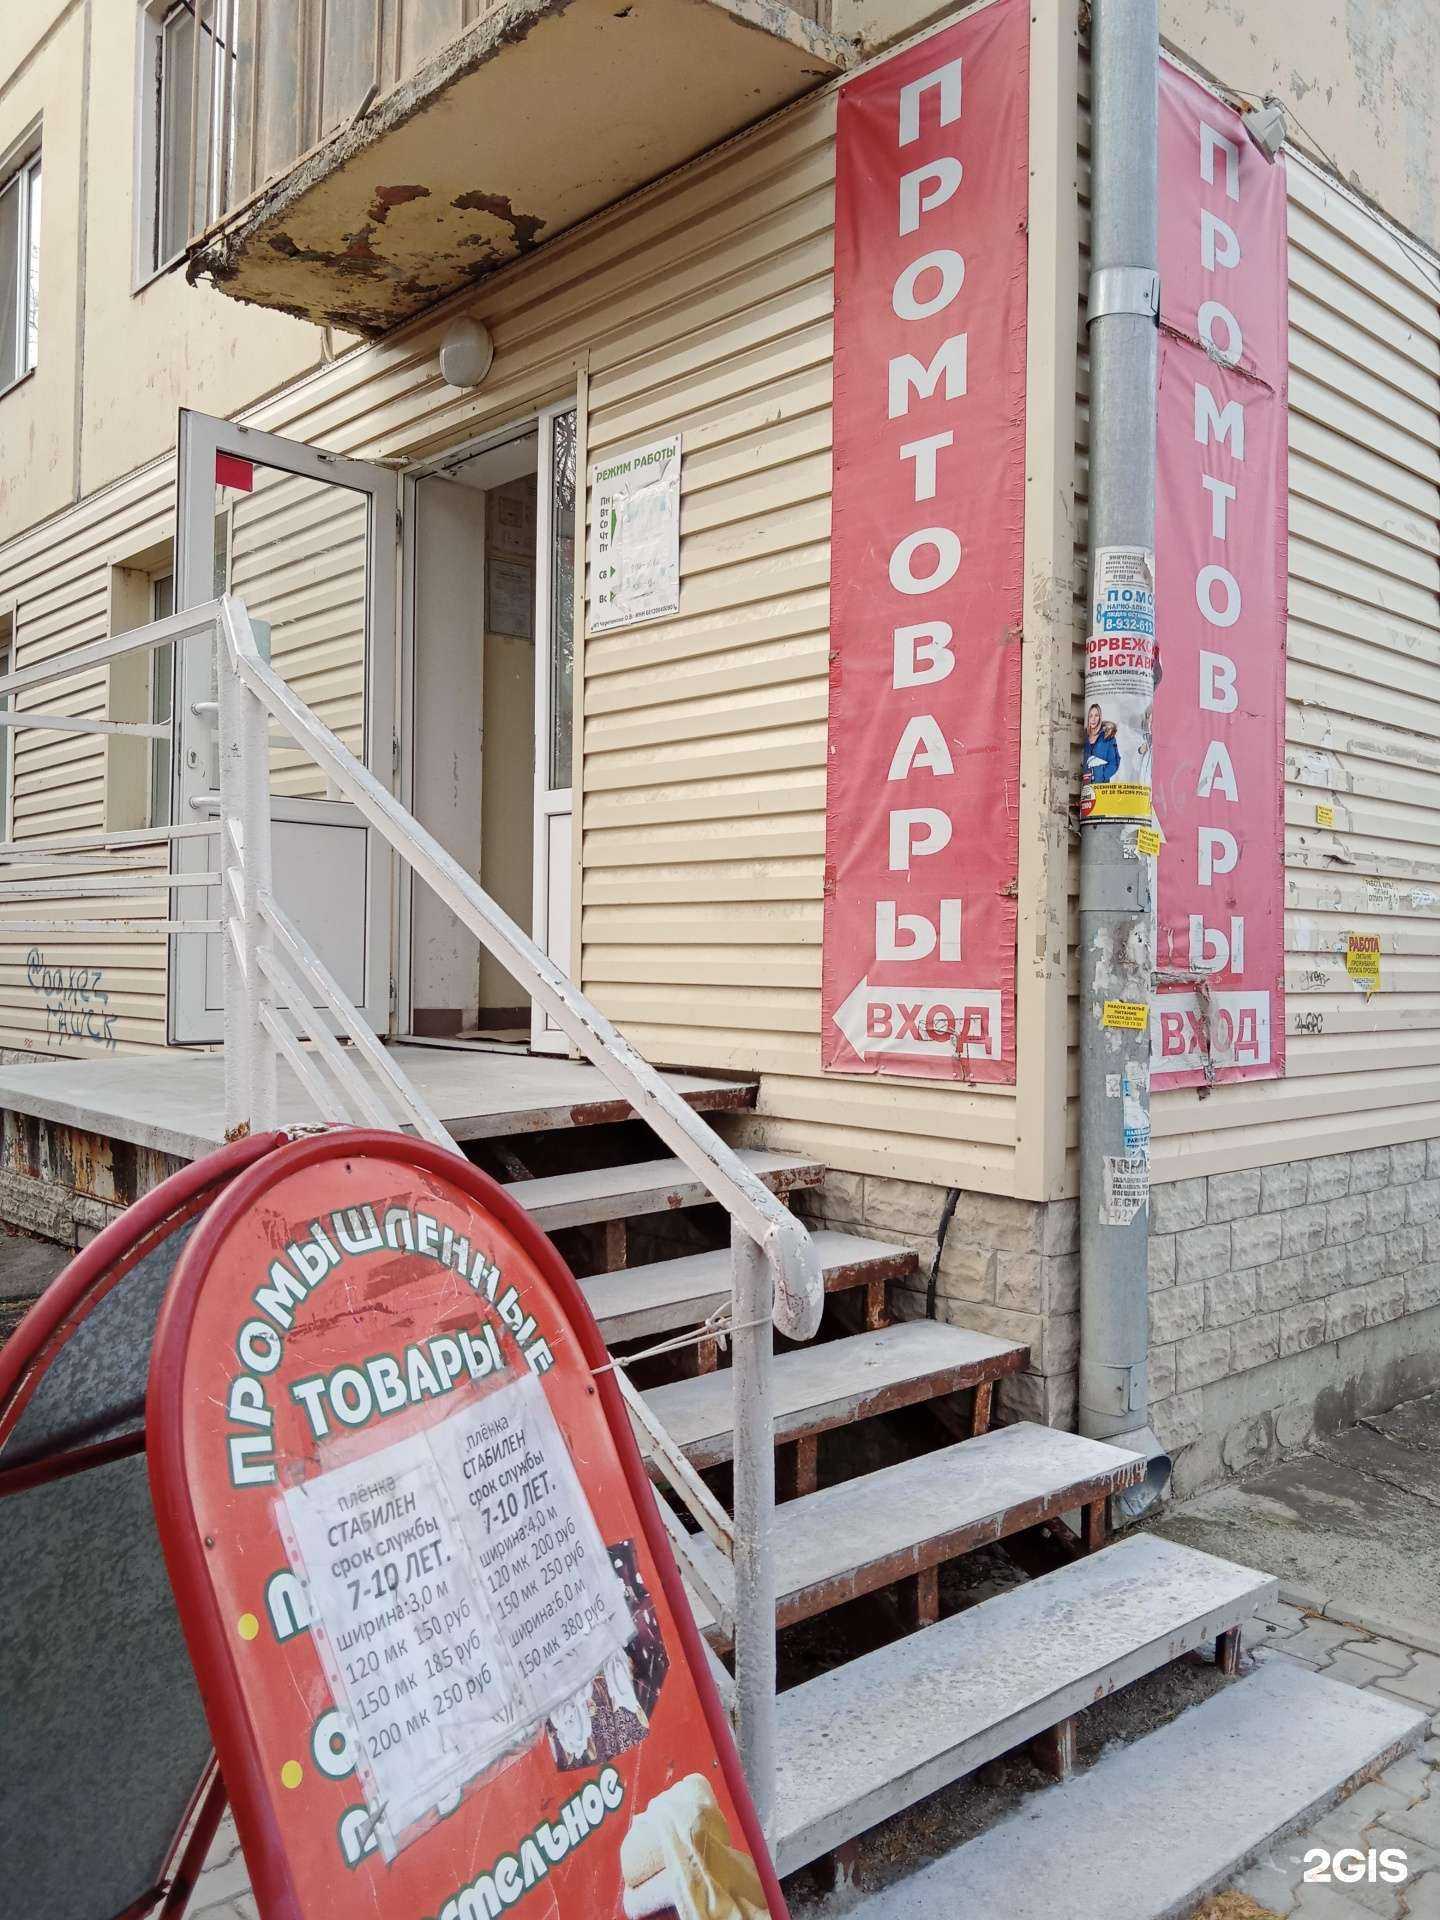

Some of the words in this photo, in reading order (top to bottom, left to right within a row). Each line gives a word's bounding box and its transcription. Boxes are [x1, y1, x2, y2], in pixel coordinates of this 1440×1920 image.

[596, 461, 631, 483] РЕЖИМ
[634, 445, 676, 469] РАБОТЫ
[875, 57, 968, 962] ПРОМТОВАРЫ
[1188, 120, 1245, 974] ПРОМТОВАРЫ
[1348, 936, 1380, 953] РАБОТА
[866, 1002, 993, 1055] ВХОД
[1160, 1008, 1259, 1061] ВХОД
[229, 1205, 554, 1485] ПРОМЫШЛЕННЫЕ
[293, 1324, 505, 1437] ТОВАРЫ
[463, 1429, 526, 1479] СТАБИЛЕН
[466, 1416, 509, 1449] плёнка
[338, 1476, 396, 1512] плёнка
[468, 1479, 498, 1507] срок
[498, 1450, 545, 1487] службы
[481, 1492, 519, 1534] 7-10
[522, 1470, 556, 1509] ЛЕТ.
[328, 1491, 416, 1547] СТАБИЛЕН
[546, 1505, 558, 1521] м
[331, 1547, 375, 1578] срок
[376, 1516, 439, 1556] службы
[347, 1562, 400, 1611] 7-10
[405, 1539, 451, 1583] ЛЕТ.
[487, 1564, 511, 1594] 120
[512, 1554, 530, 1577] мк
[531, 1533, 553, 1561] 200
[555, 1516, 576, 1547] руб
[436, 1580, 449, 1599] м
[496, 1590, 519, 1620] 150
[521, 1580, 539, 1602] мк
[540, 1557, 563, 1586] 250
[564, 1540, 585, 1573] руб
[574, 1578, 586, 1594] м
[346, 1650, 380, 1685] 120
[384, 1638, 408, 1664] мк
[413, 1616, 442, 1646] 150
[444, 1598, 471, 1633] руб
[518, 1648, 541, 1679] 150
[542, 1635, 561, 1657] мк
[561, 1612, 584, 1641] 380
[584, 1593, 605, 1630] руб
[356, 1685, 390, 1720] 150
[394, 1673, 418, 1699] мк
[424, 1647, 453, 1679] 185
[454, 1628, 481, 1664] руб
[368, 1722, 401, 1759] 200
[405, 1709, 431, 1736] мк
[433, 1682, 463, 1715] 250
[466, 1662, 492, 1700] руб
